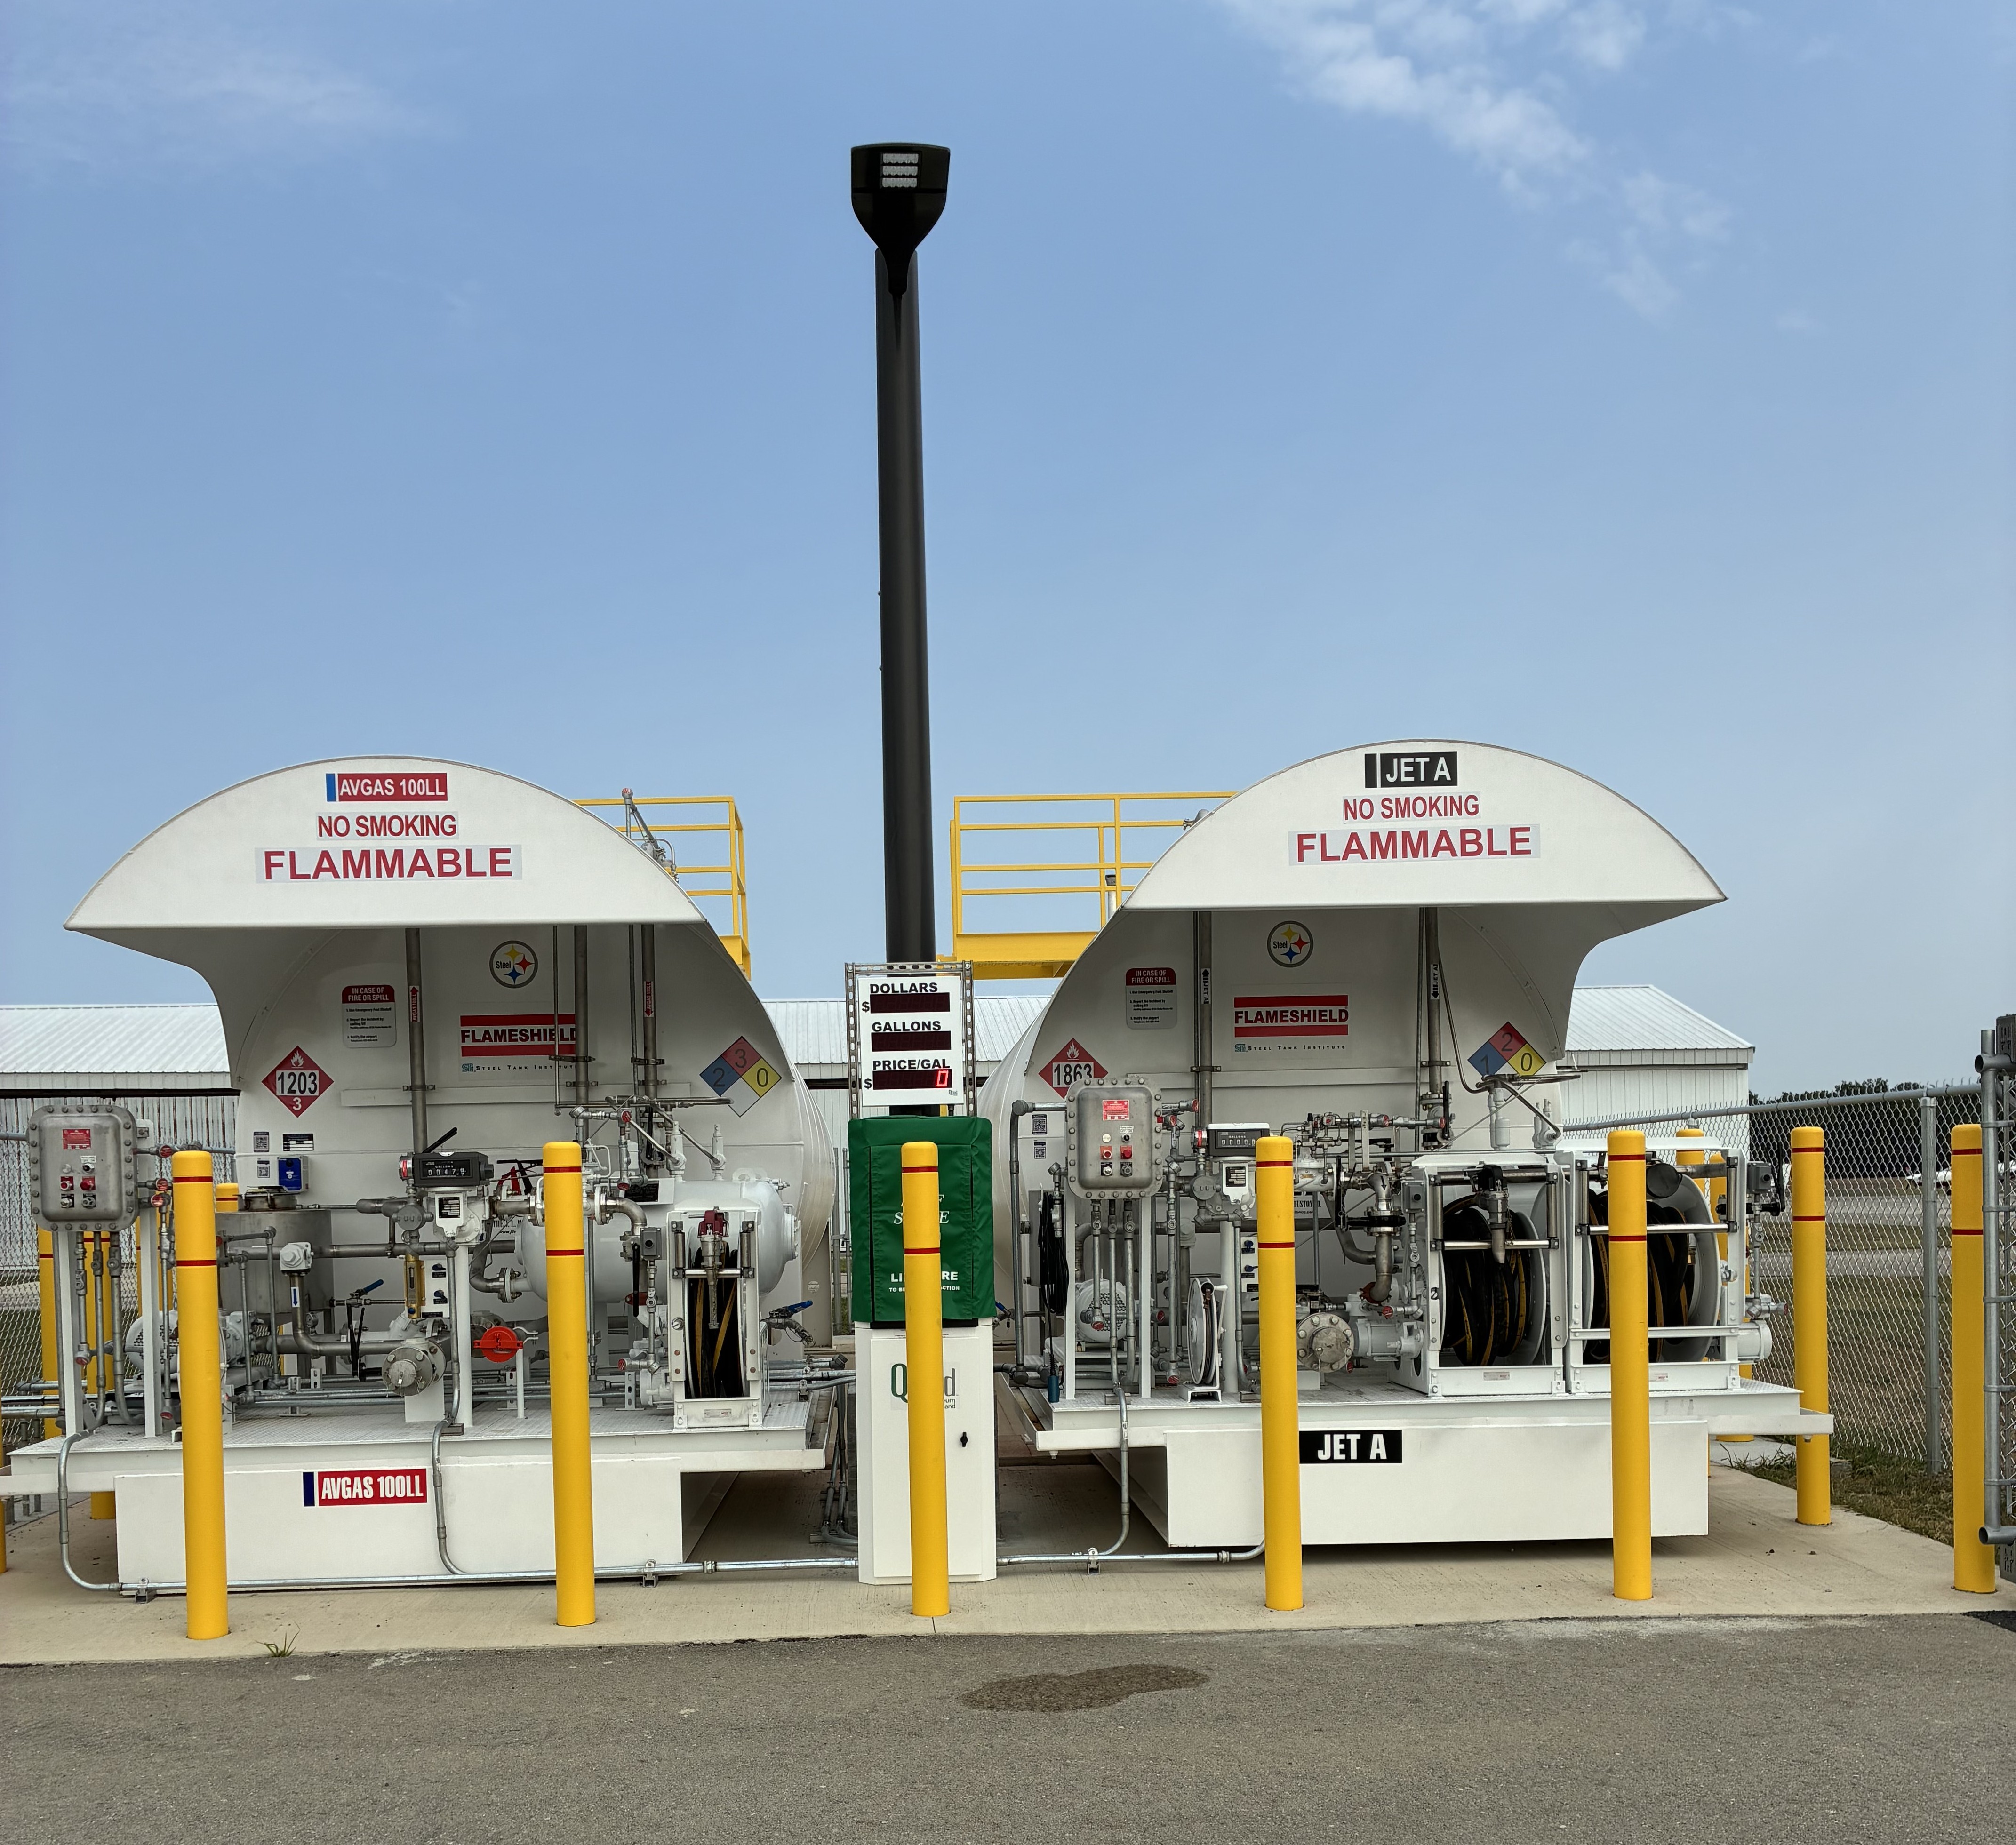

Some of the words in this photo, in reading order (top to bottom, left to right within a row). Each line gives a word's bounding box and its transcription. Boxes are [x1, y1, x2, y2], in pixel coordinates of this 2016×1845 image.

[1386, 758, 1429, 782] JET
[1434, 757, 1451, 781] A
[340, 779, 394, 796] AVGAS
[400, 778, 445, 796] 100LL
[1344, 798, 1374, 820] NO
[1381, 794, 1479, 819] SMOKING
[318, 815, 350, 837] NO
[355, 815, 456, 837] SMOKING
[1297, 827, 1531, 862] FLAMMABLE
[264, 848, 512, 879] FLAMMABLE
[870, 982, 938, 993] DOLLARS
[862, 1001, 870, 1013] $
[1235, 1009, 1349, 1024] FLAMESHIELD
[872, 1021, 941, 1032] GALLONS
[1502, 1032, 1513, 1052] 2
[735, 1048, 747, 1068] 3
[873, 1059, 950, 1070] PRICE/GAL
[1480, 1054, 1489, 1074] 1
[1521, 1053, 1532, 1071] 0
[278, 1072, 317, 1094] 1203
[713, 1068, 725, 1087] 2
[757, 1068, 768, 1087] 0
[864, 1078, 872, 1089] $
[936, 1070, 948, 1087] 0
[1054, 1063, 1092, 1086] 1863
[292, 1097, 302, 1110] 3
[1318, 1434, 1361, 1460] JET
[1369, 1434, 1387, 1460] A
[321, 1476, 374, 1500] AVGAS
[377, 1475, 424, 1498] 100LL
